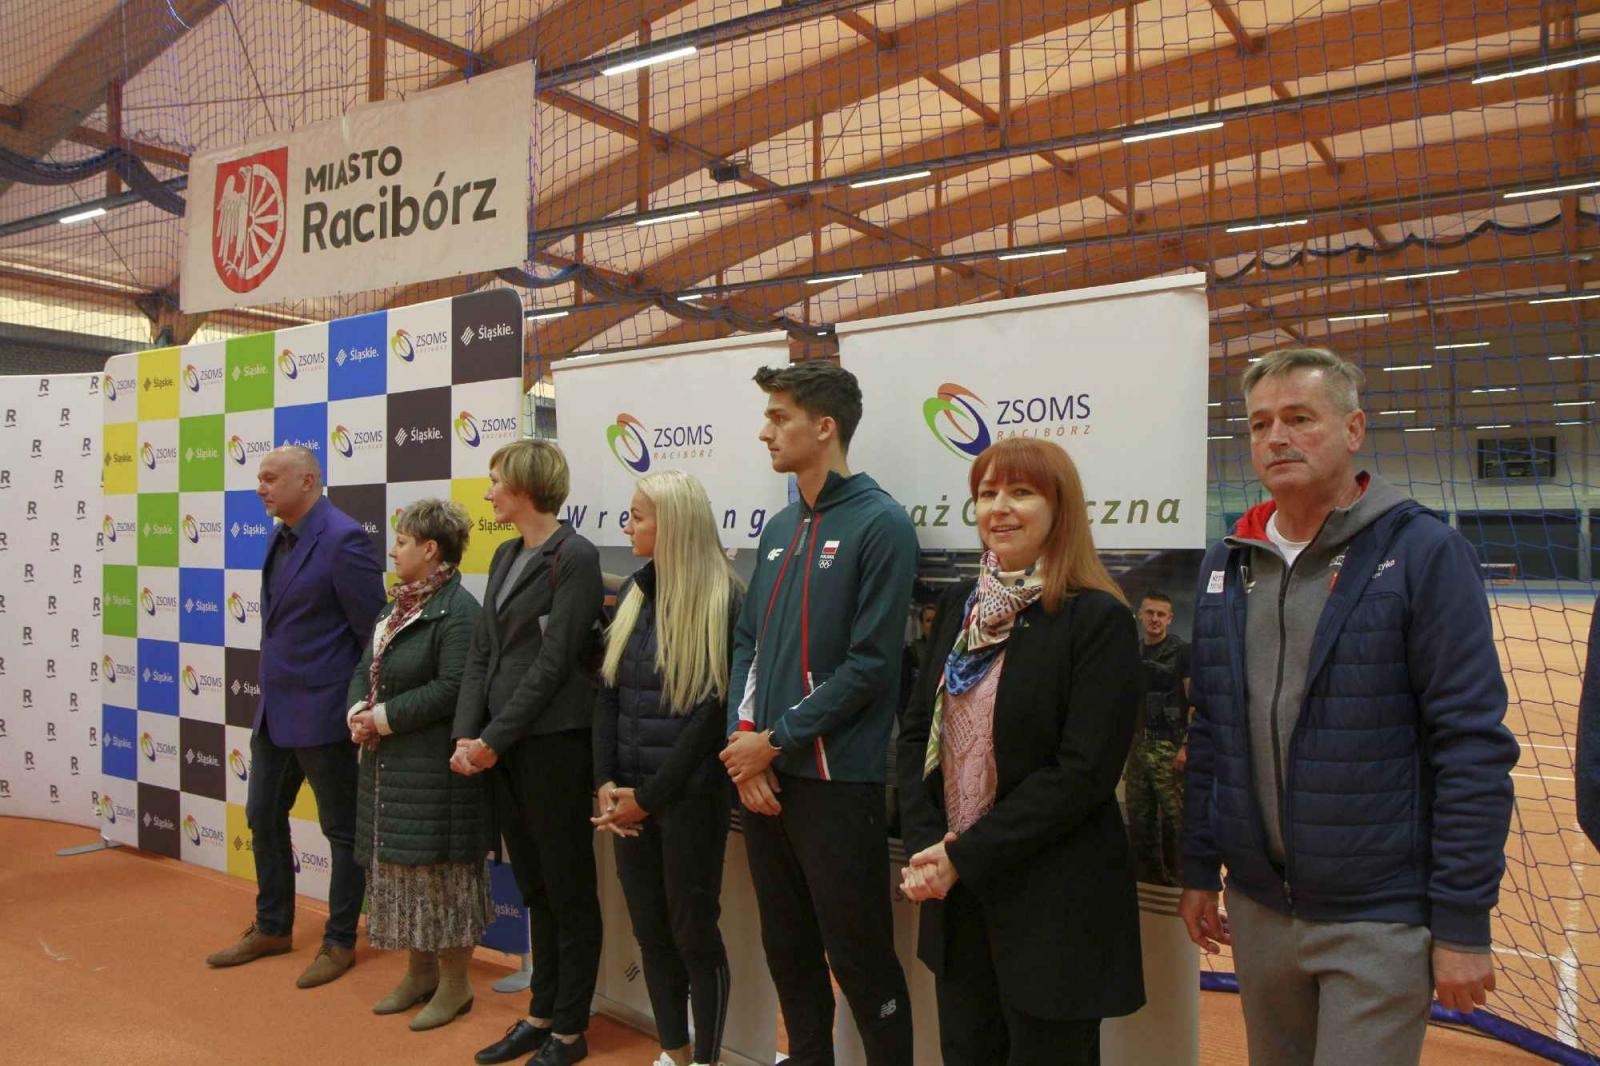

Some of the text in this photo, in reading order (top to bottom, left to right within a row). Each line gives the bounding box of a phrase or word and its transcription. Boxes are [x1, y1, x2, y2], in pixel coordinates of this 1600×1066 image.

[305, 146, 402, 195] MIASTO
[302, 170, 497, 253] Racibórz
[416, 331, 447, 346] ZSOMS
[478, 323, 514, 341] Śląskie.
[299, 353, 325, 366] ZSOMS
[350, 346, 379, 362] Śląskie.
[40, 379, 49, 391] R
[90, 376, 99, 389] R
[6, 409, 16, 422] R
[61, 408, 70, 421] R
[997, 394, 1090, 424] ZSOMS
[481, 417, 516, 431] ZSOMS
[354, 431, 383, 444] ZSOMS
[410, 426, 443, 444] Śląskie.
[654, 424, 712, 448] ZSOMS
[32, 440, 41, 452] R
[82, 438, 91, 451] R
[246, 441, 271, 453] ZSOMS
[1, 470, 10, 483] R
[55, 470, 63, 483] R
[27, 501, 37, 514] R
[77, 501, 85, 514] R
[51, 533, 59, 546] R
[96, 532, 104, 546] R
[24, 564, 33, 577] R
[74, 564, 81, 578] R
[48, 596, 56, 609] R
[93, 597, 100, 610] R
[246, 602, 259, 612] ZSO
[23, 626, 32, 640] R
[71, 628, 78, 642] R
[47, 659, 55, 672] R
[90, 662, 98, 676] R
[244, 681, 260, 696] Śląsk
[23, 689, 32, 702] R
[70, 693, 78, 706] R
[47, 722, 55, 736] R
[89, 727, 96, 741] R
[25, 752, 34, 765] R
[71, 756, 78, 770] R
[0, 780, 9, 793] R
[50, 785, 58, 798] R
[92, 791, 99, 805] R
[301, 852, 328, 868] ZSOMS
